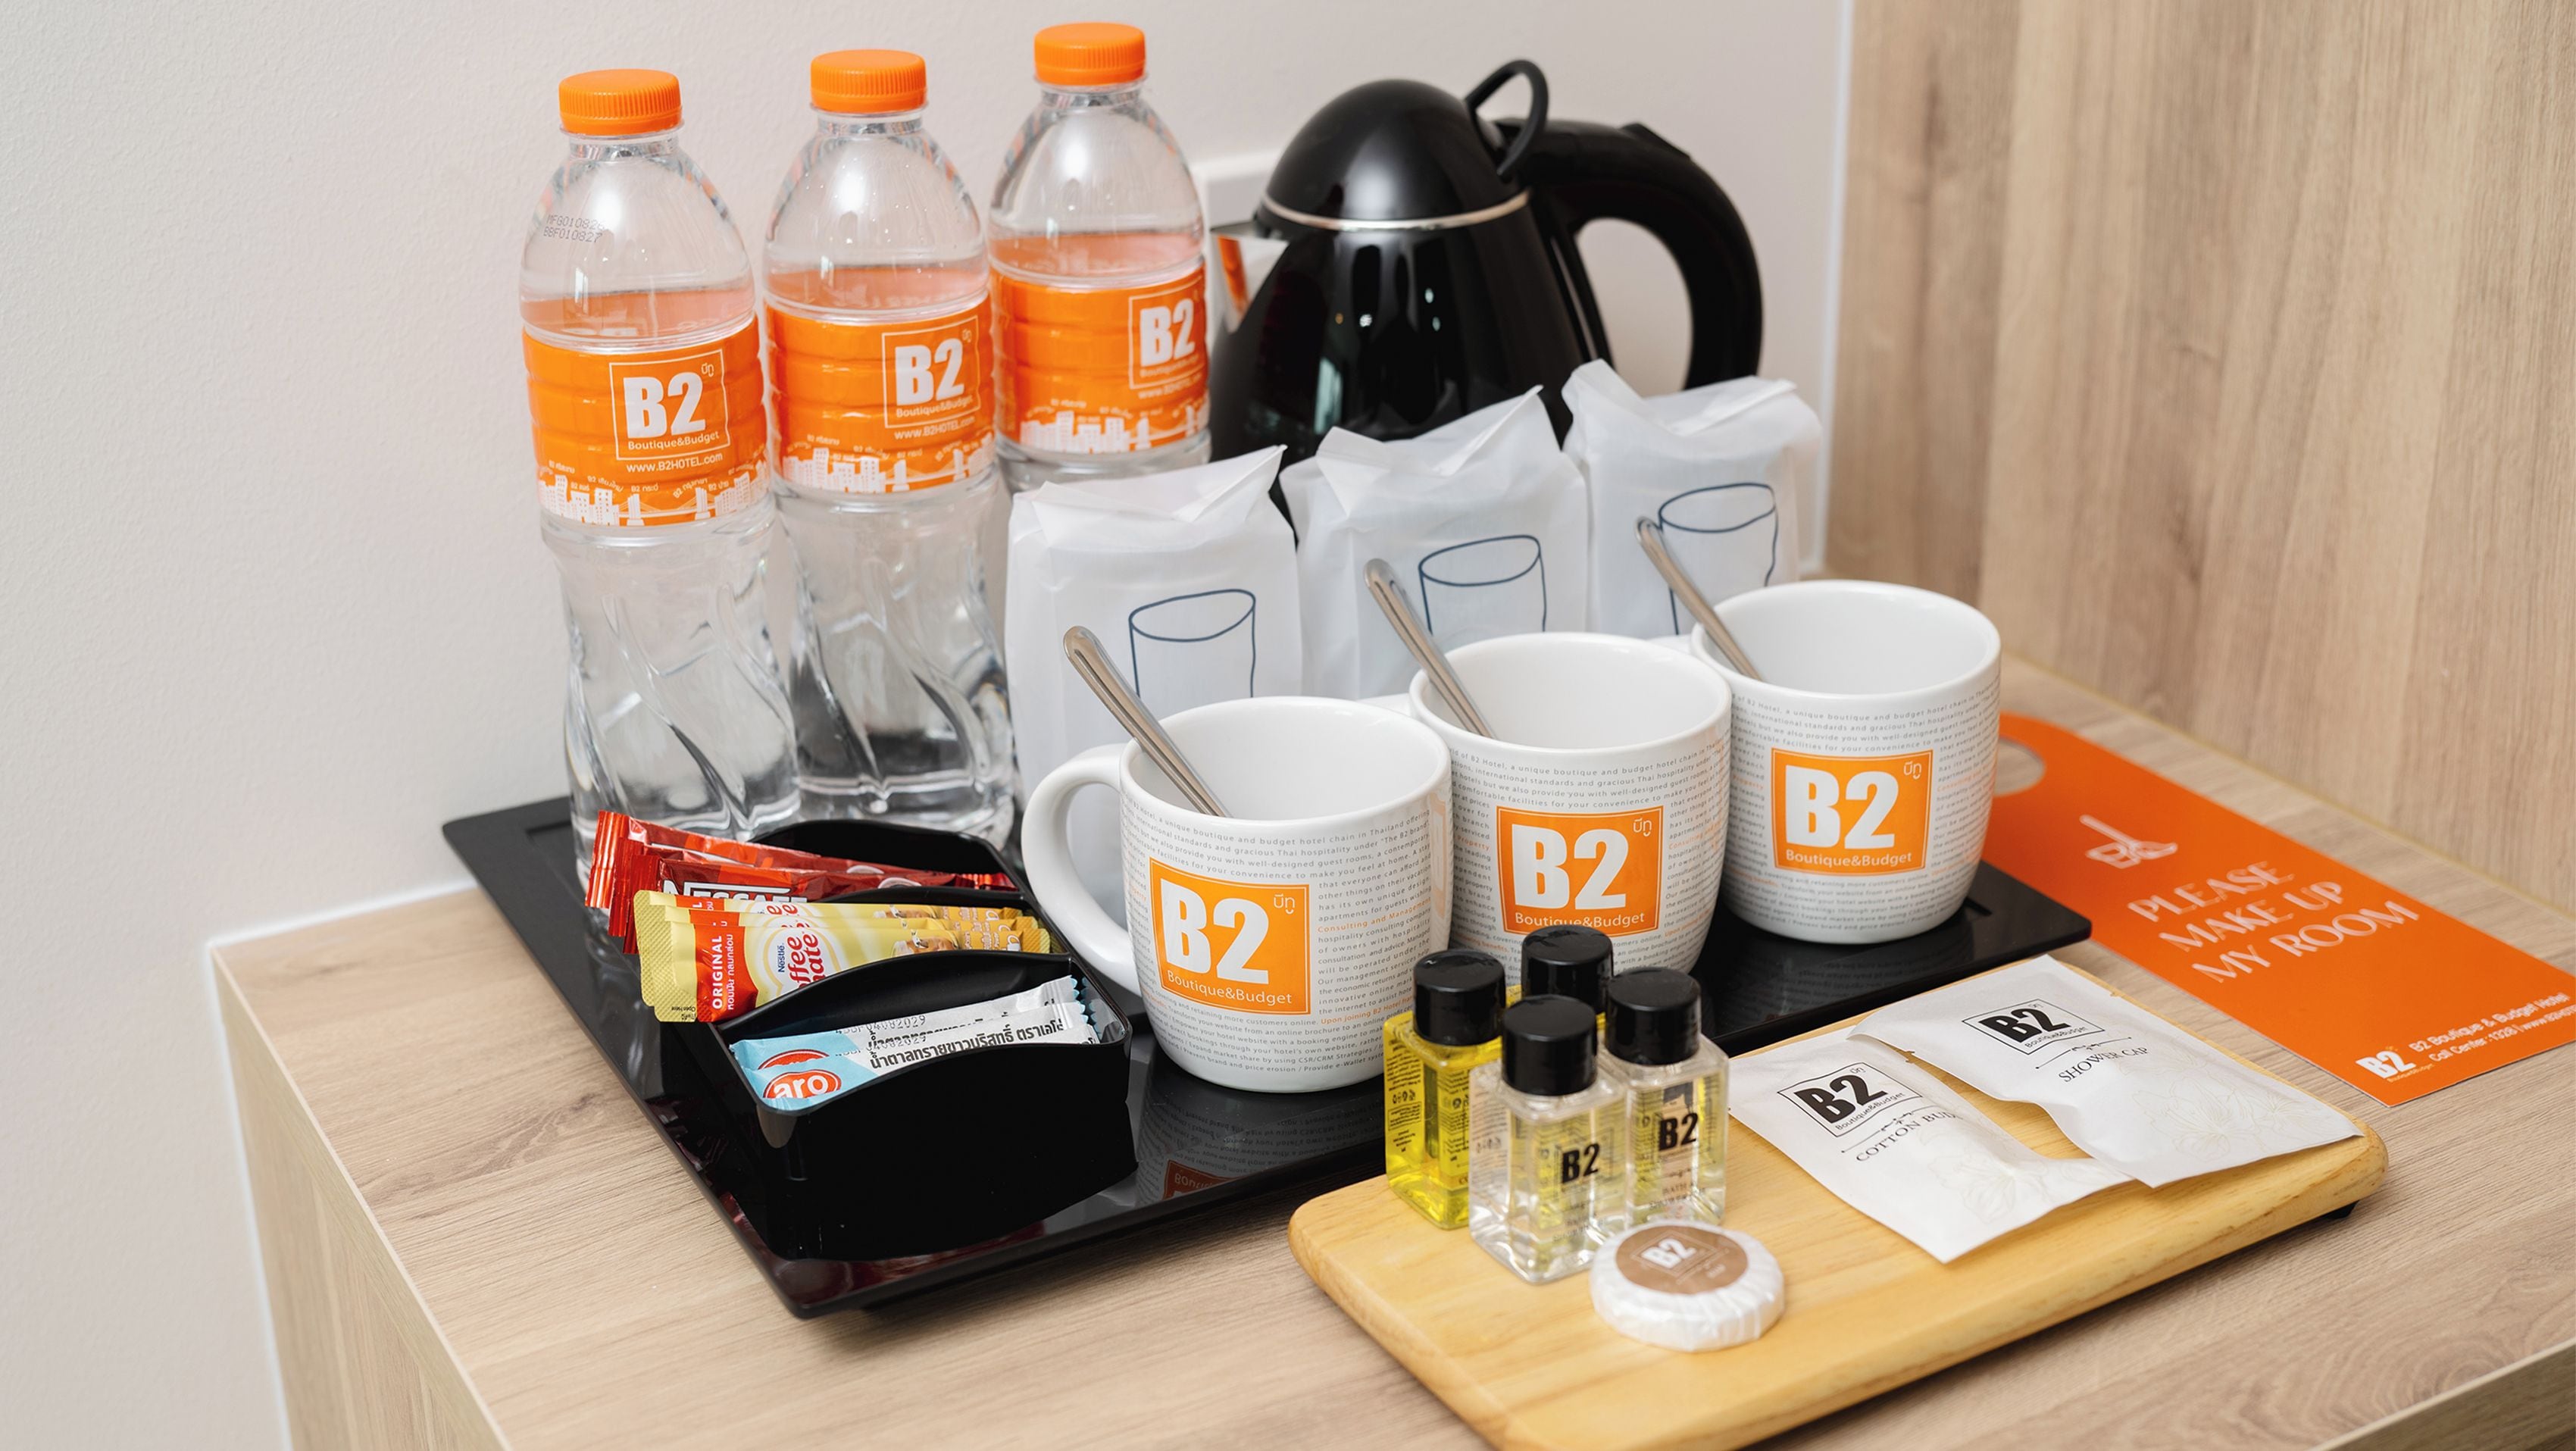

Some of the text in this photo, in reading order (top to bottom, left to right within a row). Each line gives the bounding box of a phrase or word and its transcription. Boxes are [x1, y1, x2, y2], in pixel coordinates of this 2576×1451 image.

[1140, 298, 1196, 367] B2
[895, 338, 965, 406] B2
[623, 371, 705, 439] B2
[628, 430, 719, 451] Boutique&Budget
[627, 453, 724, 473] www.B2HOTEL.com
[1894, 711, 1924, 719] budget
[1518, 765, 1550, 775] unique
[1554, 768, 1597, 777] boutique
[1621, 764, 1653, 774] budget
[1656, 758, 1677, 768] hotel
[1530, 778, 1574, 786] standards
[1597, 778, 1635, 787] gracious
[1785, 765, 1899, 849] B2
[1166, 820, 1190, 833] unique
[1194, 828, 1234, 842] boutique
[1260, 838, 1296, 846] budget
[1329, 833, 1355, 843] chain
[1370, 821, 1404, 836] Thailand
[1406, 809, 1430, 825] offering
[1174, 834, 1212, 849] standards
[1301, 845, 1350, 857] hospitality
[1355, 841, 1377, 851] under
[1161, 840, 1174, 849] also
[1175, 846, 1205, 858] provide
[1206, 854, 1222, 862] you
[1248, 860, 1314, 869] well-designed
[1318, 858, 1343, 868] guest
[1346, 853, 1374, 863] rooms,
[1383, 833, 1430, 855] contemporary
[1512, 824, 1628, 910] B2
[1786, 849, 1913, 868] Boutique&Budget
[1192, 861, 1203, 869] for
[1207, 865, 1227, 874] your
[1230, 870, 1292, 879] convenience
[1309, 870, 1334, 879] make
[1358, 864, 1374, 872] feel
[1341, 874, 1382, 886] everyone
[1383, 869, 1397, 877] can
[1399, 859, 1419, 872] afford
[1318, 892, 1343, 900] other
[1346, 887, 1373, 896] things
[1387, 877, 1405, 887] their
[1340, 901, 1352, 909] its
[1355, 898, 1374, 906] own
[1377, 888, 1405, 902] unique
[2127, 861, 2295, 922] PLEASE
[1318, 910, 1369, 922] apartments
[1371, 906, 1383, 915] for
[1384, 899, 1408, 912] guests
[1318, 896, 1431, 933] Consulting and Management
[1515, 912, 1645, 927] Boutique&Budget
[2159, 881, 2343, 952] MAKE UP
[1161, 878, 1269, 985] B2
[1318, 932, 1364, 943] hospitality
[1365, 921, 1405, 937] consulting
[2192, 900, 2419, 983] MY ROOM
[712, 936, 723, 1009] ORIGINAL
[786, 937, 811, 989] ffee
[1167, 970, 1292, 1006] Boutique&Budget
[1978, 1009, 2071, 1043] B2
[2408, 1040, 2432, 1052] B2
[2427, 1023, 2484, 1046] Boutique
[2481, 1018, 2496, 1027] &
[2492, 1002, 2539, 1023] Budget
[2059, 1046, 2149, 1083] SHOWER CAP
[2356, 1050, 2417, 1079] B2
[2428, 1049, 2454, 1062] Call
[2449, 1037, 2487, 1054] Center
[774, 1075, 829, 1098] aro
[1793, 1074, 1888, 1124] B2
[1834, 1091, 1905, 1130] Boutique&Budget
[1659, 1112, 1698, 1151] B2
[1856, 1121, 1921, 1162] COTTON
[1562, 1143, 1600, 1184] B2
[1641, 1238, 1697, 1268] B2
